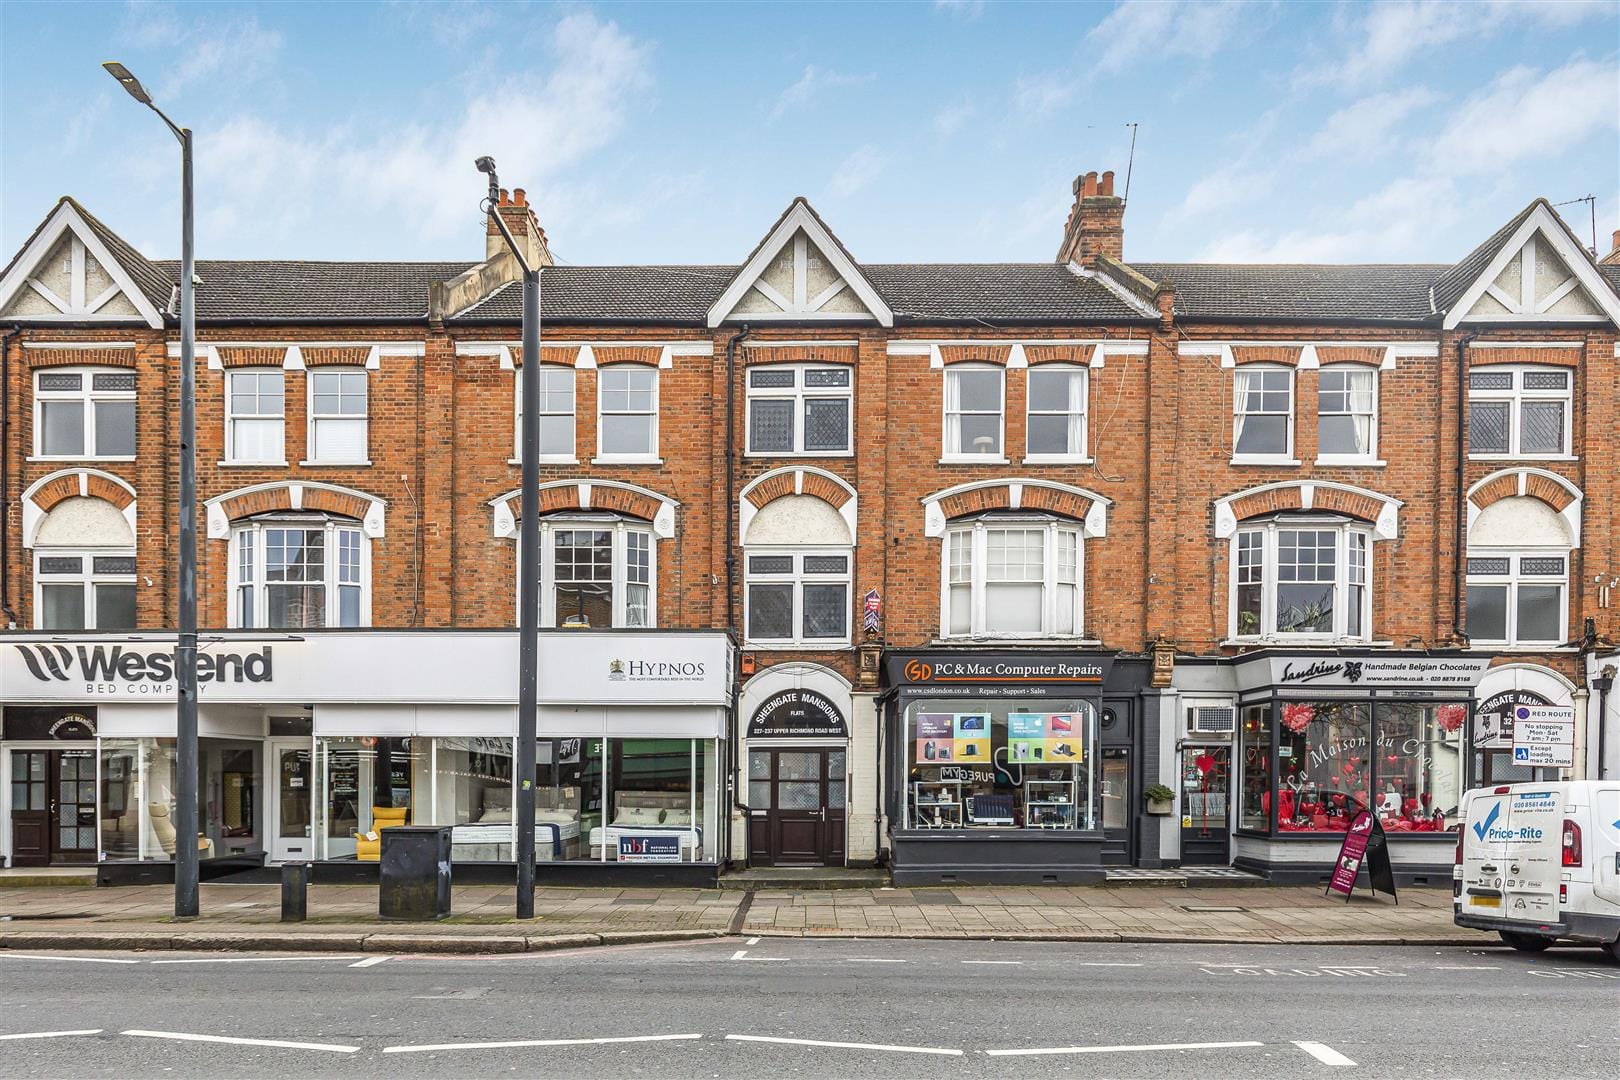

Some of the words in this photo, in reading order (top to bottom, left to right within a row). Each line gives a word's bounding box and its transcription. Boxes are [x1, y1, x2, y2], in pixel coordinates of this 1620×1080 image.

[629, 660, 705, 676] HYPNOS
[904, 658, 932, 682] CSD
[935, 664, 953, 674] PC
[954, 664, 965, 674] &
[967, 664, 992, 675] Mac
[996, 664, 1057, 677] Computer
[1058, 664, 1102, 677] Repairs
[1281, 661, 1343, 683] Sandrine
[1365, 663, 1407, 671] Handmade
[1409, 663, 1438, 672] Belgian
[1440, 663, 1482, 671] Chocolates
[87, 684, 117, 694] BED
[127, 684, 207, 694] COMPY
[755, 693, 797, 724] SHEENGATE
[801, 693, 840, 724] MANSIONS
[1310, 736, 1366, 768] Maison
[1376, 730, 1394, 747] du
[1489, 827, 1543, 839] Price-Rite
[622, 839, 649, 853] nbf
[1199, 968, 1407, 977] LOADING
